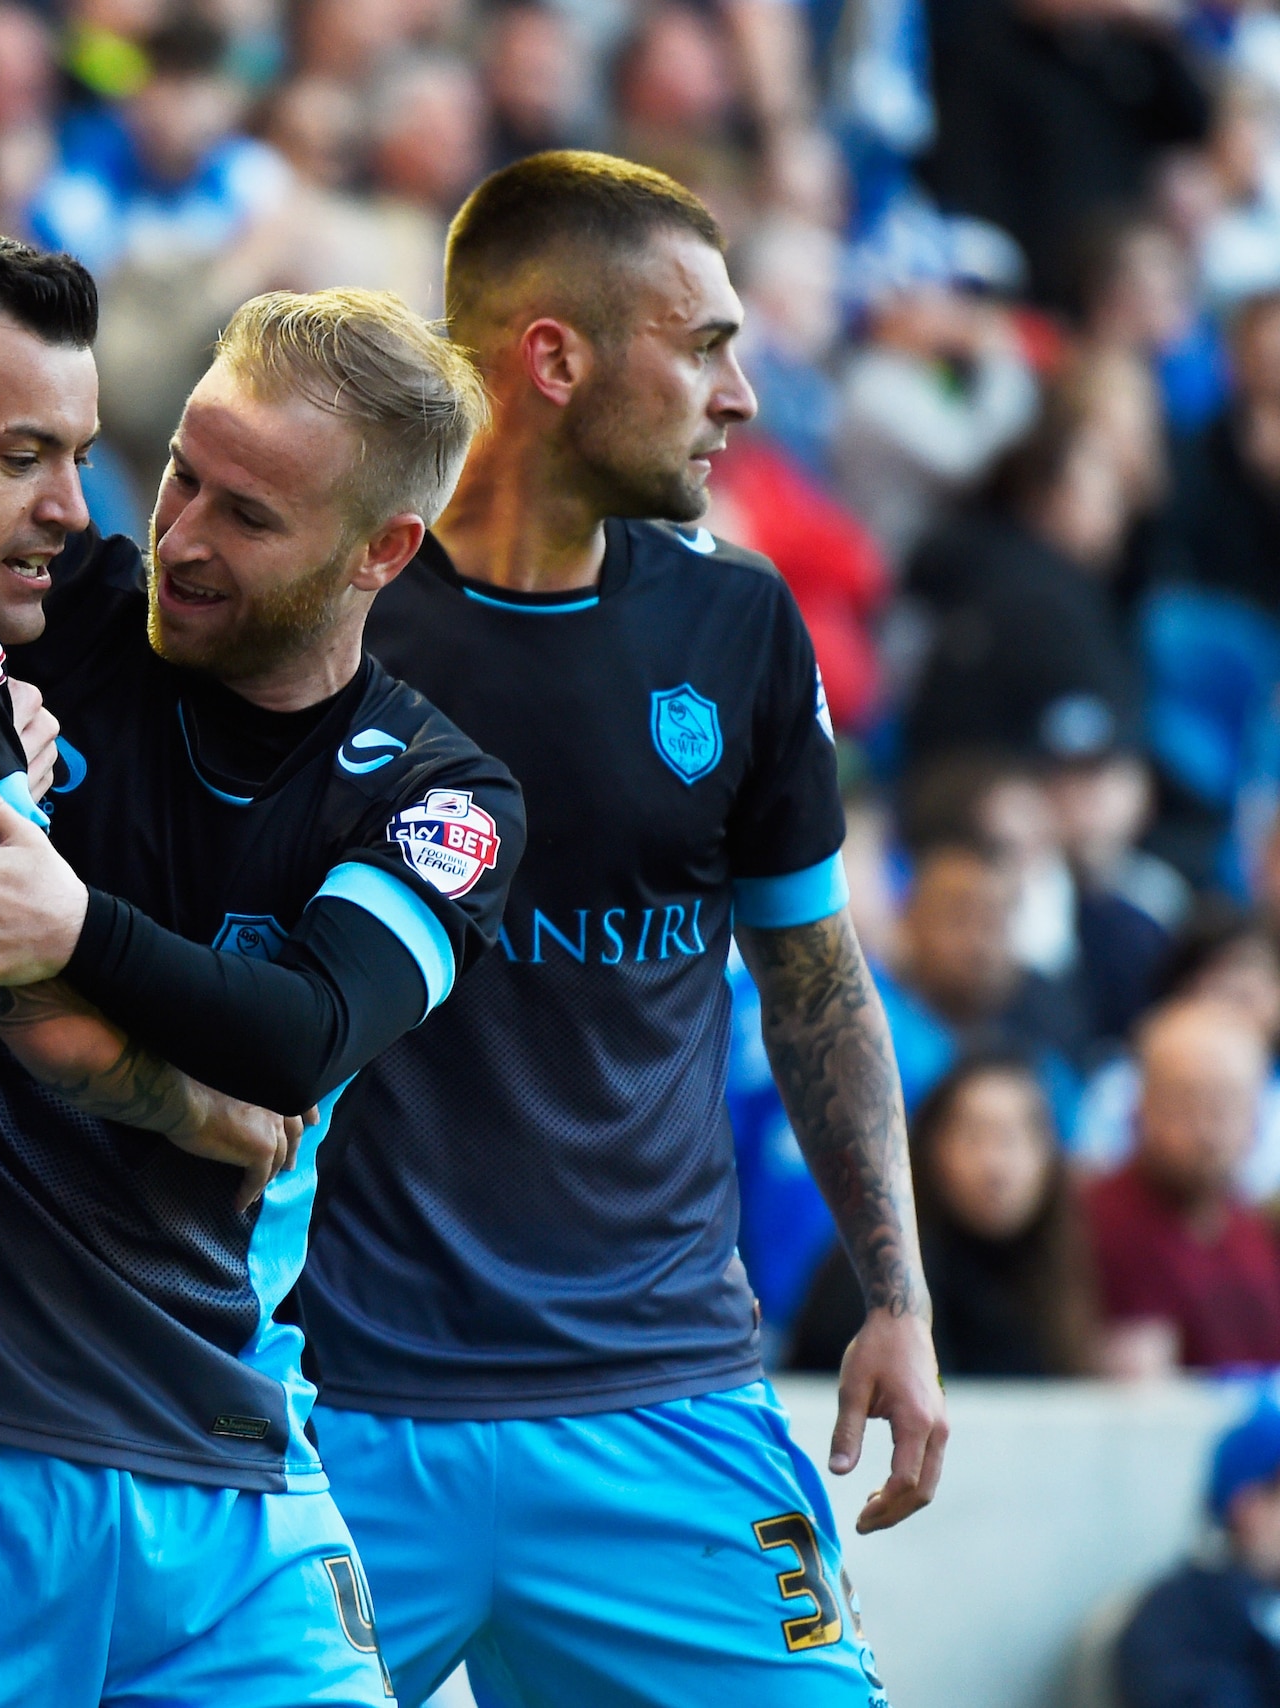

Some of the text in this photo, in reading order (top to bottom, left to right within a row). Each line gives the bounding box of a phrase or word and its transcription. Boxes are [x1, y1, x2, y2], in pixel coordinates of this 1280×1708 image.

[395, 822, 493, 859] sky BET
[416, 854, 467, 878] LEAGUE
[421, 846, 468, 868] FOOTBALL
